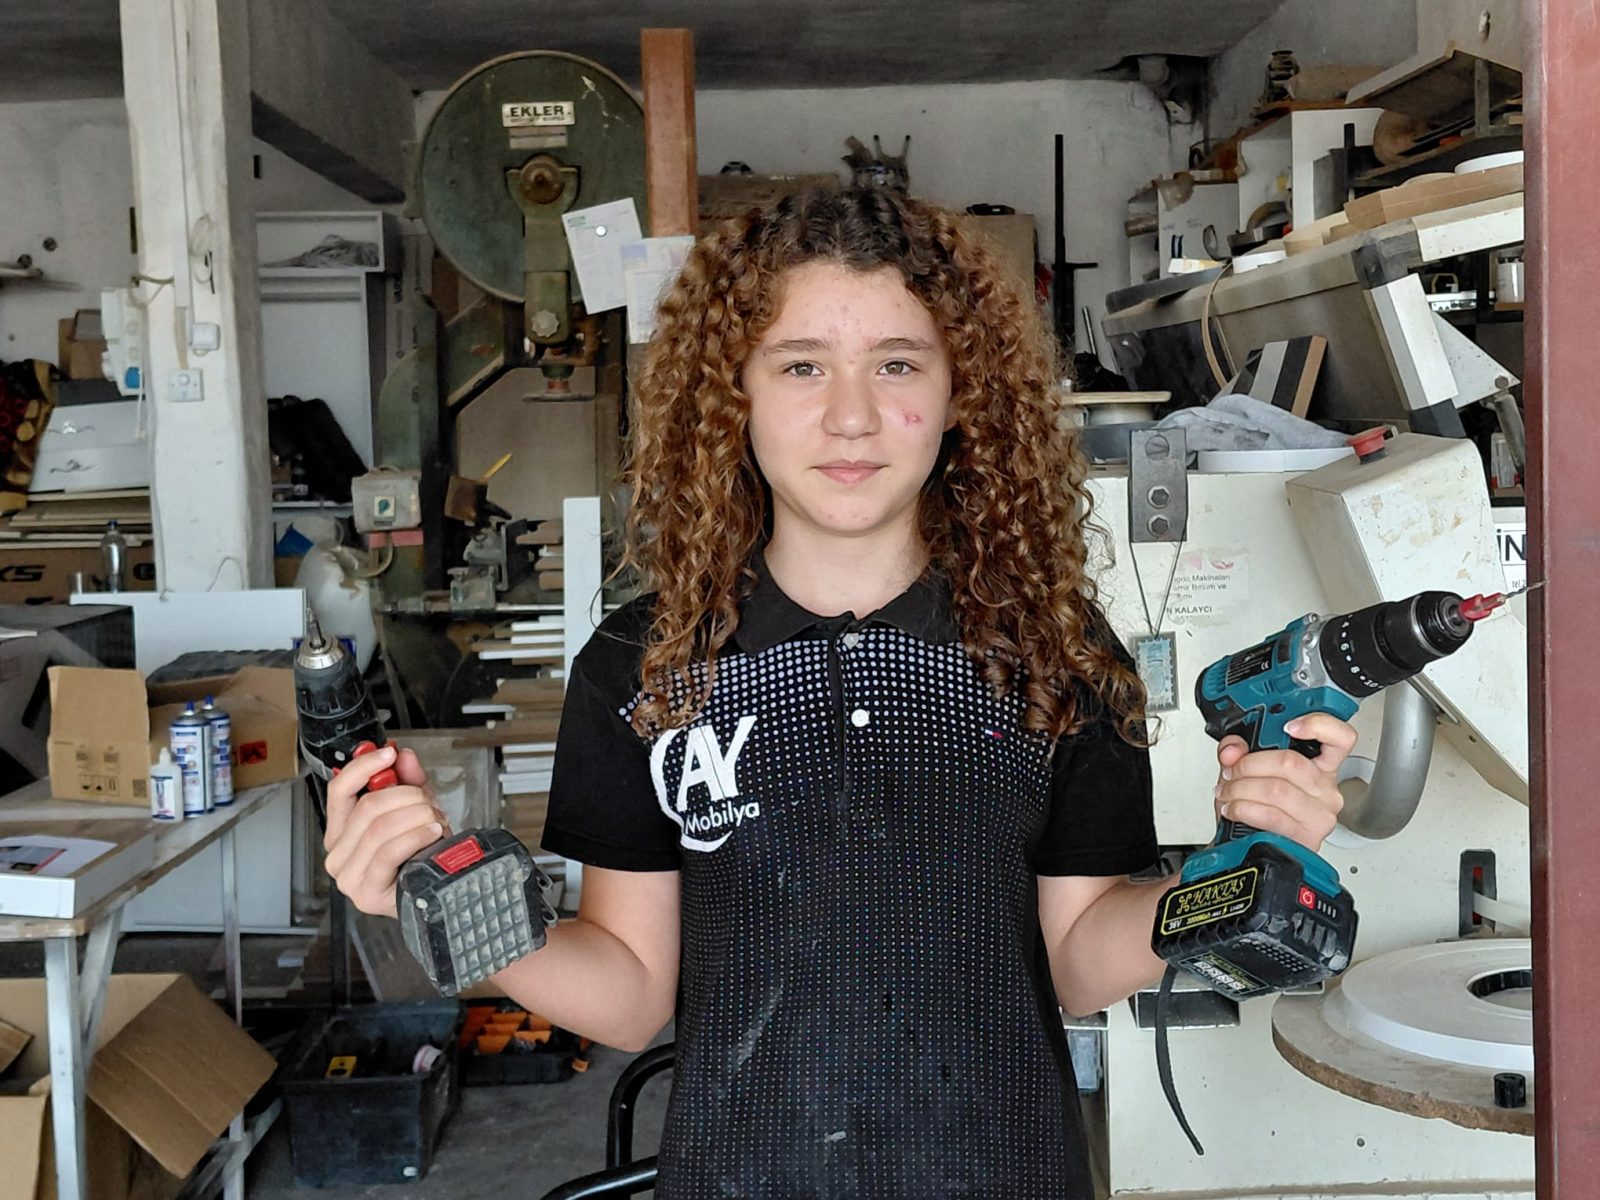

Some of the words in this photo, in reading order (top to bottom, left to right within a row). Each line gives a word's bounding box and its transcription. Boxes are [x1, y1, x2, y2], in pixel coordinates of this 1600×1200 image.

[510, 105, 564, 117] EKLER
[1350, 665, 1360, 674] 8
[686, 802, 760, 834] Mobilya
